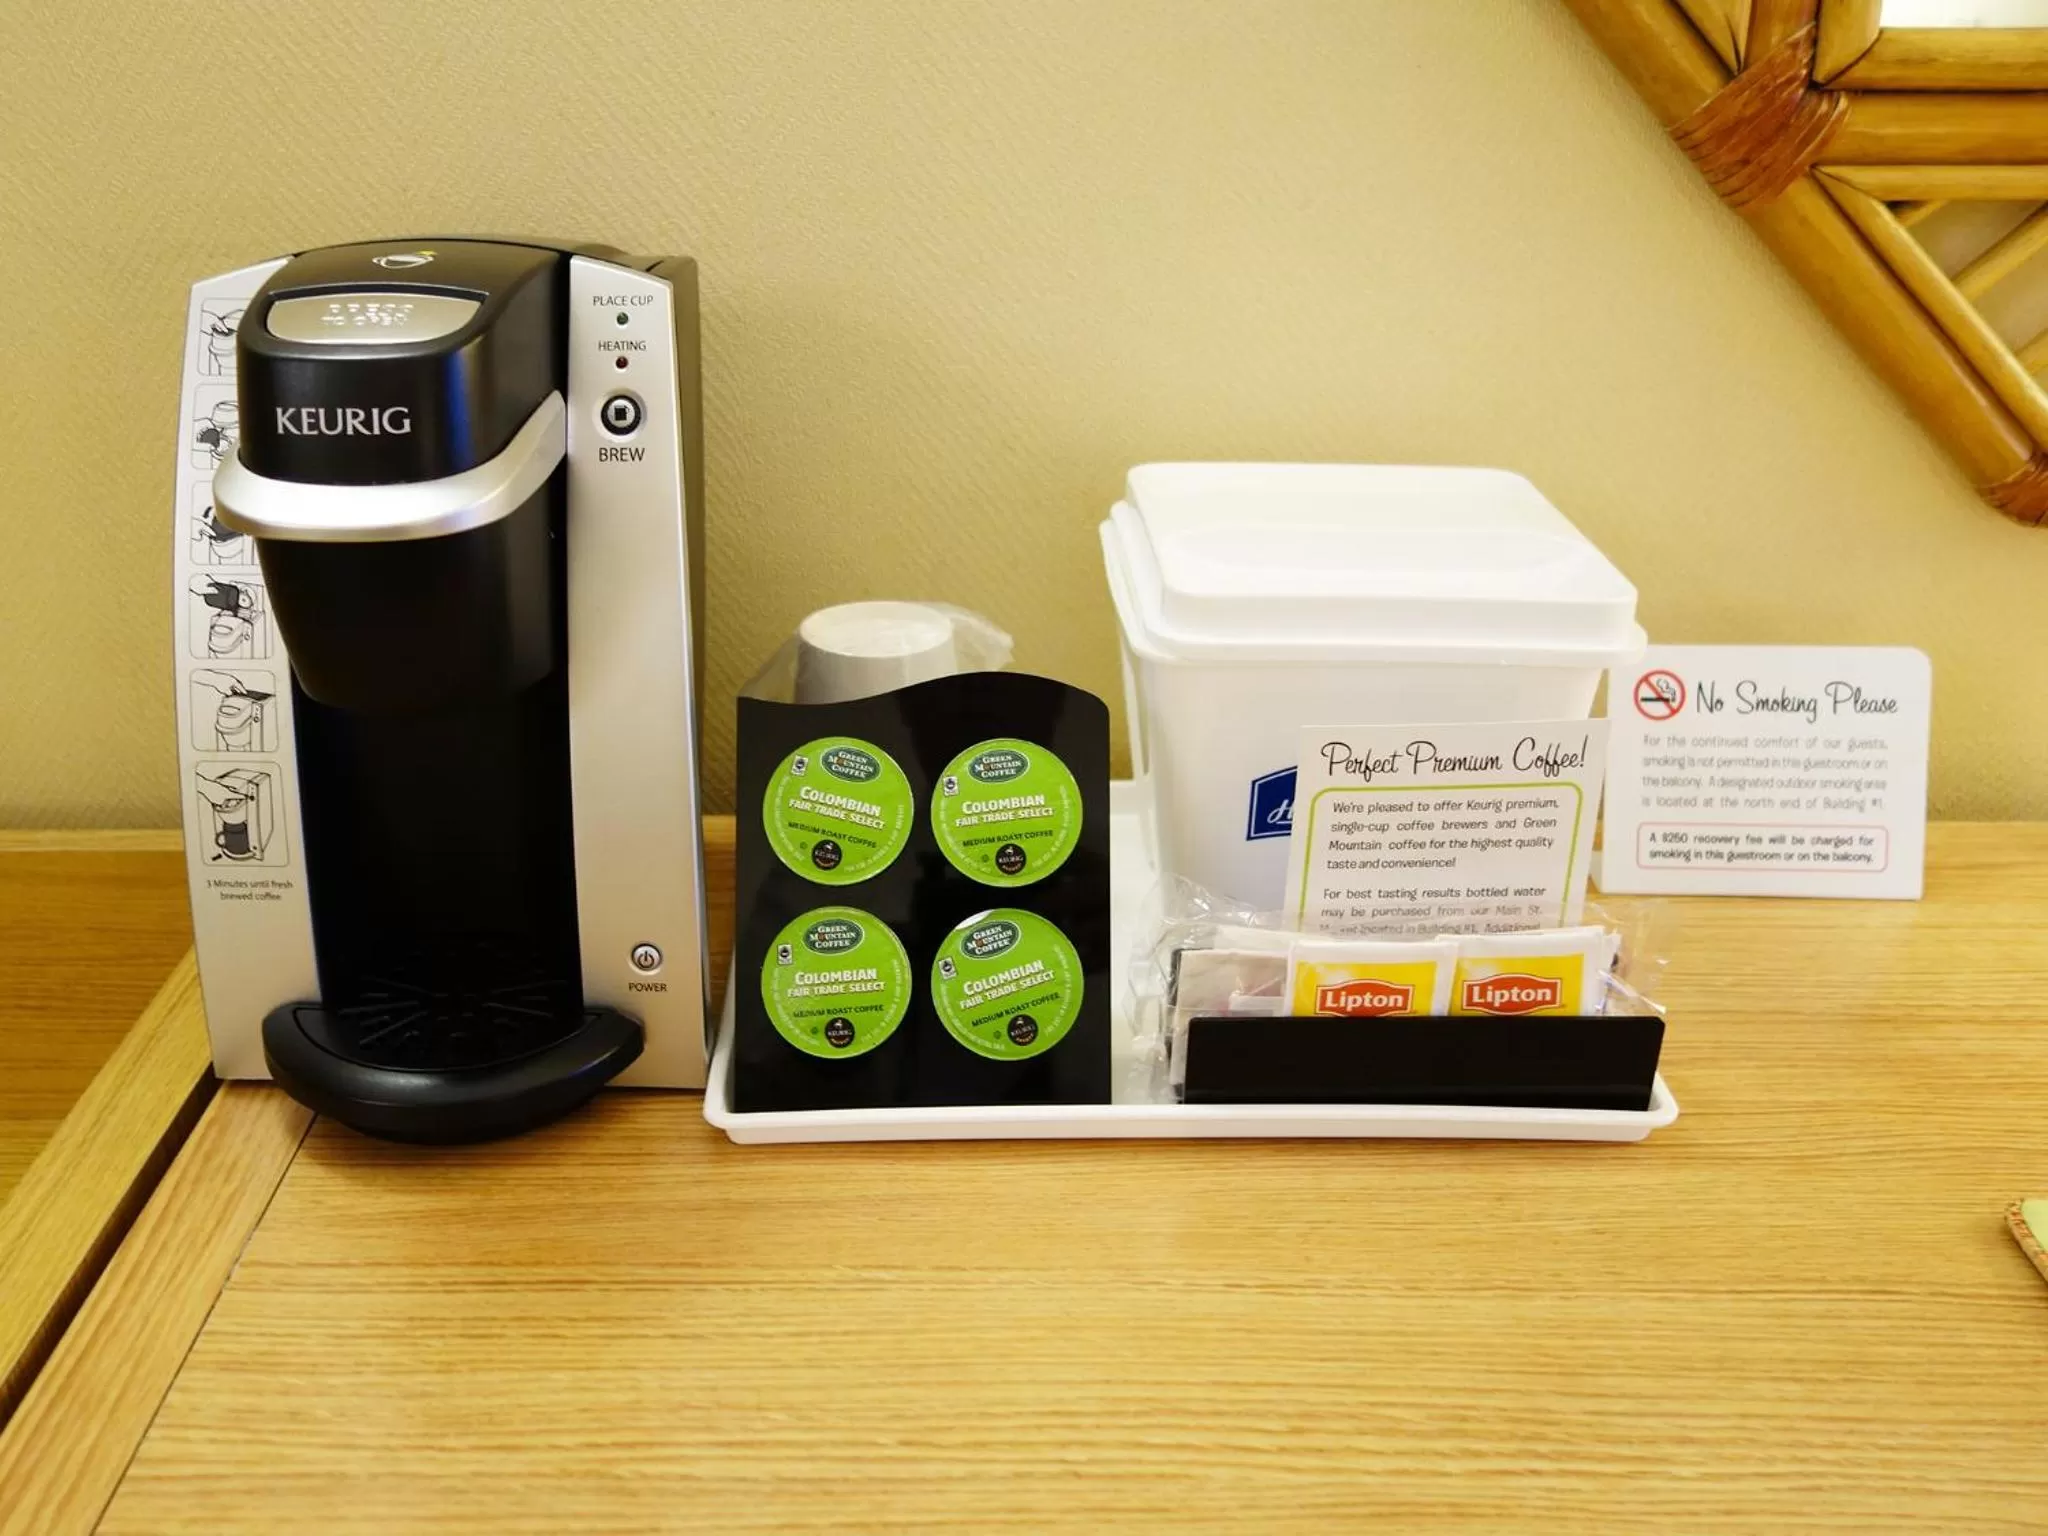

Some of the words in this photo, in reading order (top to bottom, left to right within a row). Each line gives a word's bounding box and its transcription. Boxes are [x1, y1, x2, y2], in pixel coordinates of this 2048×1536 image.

[593, 296, 627, 306] PLACE
[631, 295, 653, 306] CUP
[598, 340, 646, 351] HEATING
[276, 407, 411, 435] KEURIG
[599, 448, 645, 462] BREW
[1697, 680, 1724, 713] No
[1736, 680, 1817, 724] Smoking
[1824, 681, 1898, 715] Please
[828, 756, 873, 772] MOUNTAIN
[839, 751, 866, 764] GREEN
[983, 755, 1011, 763] GREEN
[1321, 741, 1403, 783] Perfect
[1406, 740, 1503, 775] Premium
[1513, 734, 1588, 778] Coffee!
[832, 764, 866, 778] COFFEE
[974, 760, 1021, 772] MOUNTAIN
[981, 769, 1016, 778] COFFEE
[800, 786, 881, 816] COLOMBIAN
[962, 794, 1045, 814] COLOMBIAN
[1333, 802, 1364, 813] We're
[1367, 801, 1413, 815] pleased
[1418, 801, 1430, 812] to
[1433, 800, 1462, 812] offer
[1467, 799, 1503, 813] Keurig
[789, 800, 812, 811] FAIR
[815, 804, 847, 820] TRADE
[850, 814, 884, 829] SELECT
[955, 816, 978, 826] FAIR
[984, 811, 1015, 823] TRADE
[1019, 808, 1053, 819] SELECT
[1331, 821, 1389, 835] single-cup
[1397, 820, 1435, 831] coffee
[1442, 820, 1488, 830] brewers
[1495, 818, 1517, 829] and
[1523, 817, 1557, 828] Green
[788, 822, 819, 834] MEDIUM
[821, 828, 846, 840] ROAST
[848, 835, 877, 848] COFFEE
[962, 837, 995, 847] MEDIUM
[997, 833, 1022, 843] ROAST
[1024, 830, 1053, 839] COFFEE
[1650, 832, 1657, 843] A
[1694, 835, 1740, 846] recovery
[1746, 834, 1763, 845] fee
[1768, 834, 1786, 845] will
[1791, 836, 1805, 846] be
[1811, 836, 1853, 848] charged
[1859, 836, 1874, 846] for
[1329, 840, 1382, 851] Mountain
[1388, 839, 1426, 850] coffee
[1430, 838, 1446, 849] for
[1449, 838, 1469, 849] the
[1470, 838, 1513, 852] highest
[1515, 837, 1554, 849] quality
[1327, 859, 1357, 869] taste
[1359, 858, 1380, 869] and
[1650, 849, 1691, 863] smoking
[1694, 850, 1702, 860] in
[1705, 850, 1724, 860] this
[1727, 851, 1781, 863] guestroom
[1784, 852, 1794, 861] or
[1797, 852, 1810, 861] on
[1813, 851, 1830, 862] the
[213, 880, 248, 889] Minutes
[249, 880, 270, 889] until
[271, 880, 293, 889] fresh
[220, 892, 252, 900] brewed
[254, 892, 280, 900] coffee
[1324, 888, 1341, 899] For
[1347, 888, 1372, 899] best
[1378, 888, 1417, 902] tasting
[1422, 887, 1461, 898] results
[1466, 887, 1509, 898] bottled
[1514, 887, 1547, 897] water
[1321, 908, 1346, 919] may
[1351, 907, 1366, 917] be
[1372, 906, 1432, 918] purchased
[1437, 905, 1465, 917] from
[1470, 906, 1490, 916] our
[1496, 905, 1522, 916] Main
[809, 932, 855, 941] MOUNTAIN
[966, 930, 1012, 949] MOUNTAIN
[973, 927, 1002, 939] GREEN
[815, 940, 850, 948] COFFEE
[975, 939, 1009, 955] COFFEE
[795, 969, 877, 985] COLOMBIAN
[964, 960, 1044, 995] COLOMBIAN
[628, 983, 667, 992] POWER
[788, 986, 810, 997] FAIR
[814, 984, 846, 995] TRADE
[850, 982, 884, 991] SELECT
[960, 996, 984, 1009] FAIR
[986, 985, 1017, 1000] TRADE
[1020, 971, 1054, 989] SELECT
[1326, 991, 1403, 1012] Lipton
[1472, 985, 1552, 1007] Lipton
[794, 1009, 825, 1018] MEDIUM
[854, 1005, 884, 1013] COFFEE
[972, 1011, 1004, 1027] MEDIUM
[1004, 1002, 1030, 1017] ROAST
[1031, 993, 1059, 1008] COFFEE
